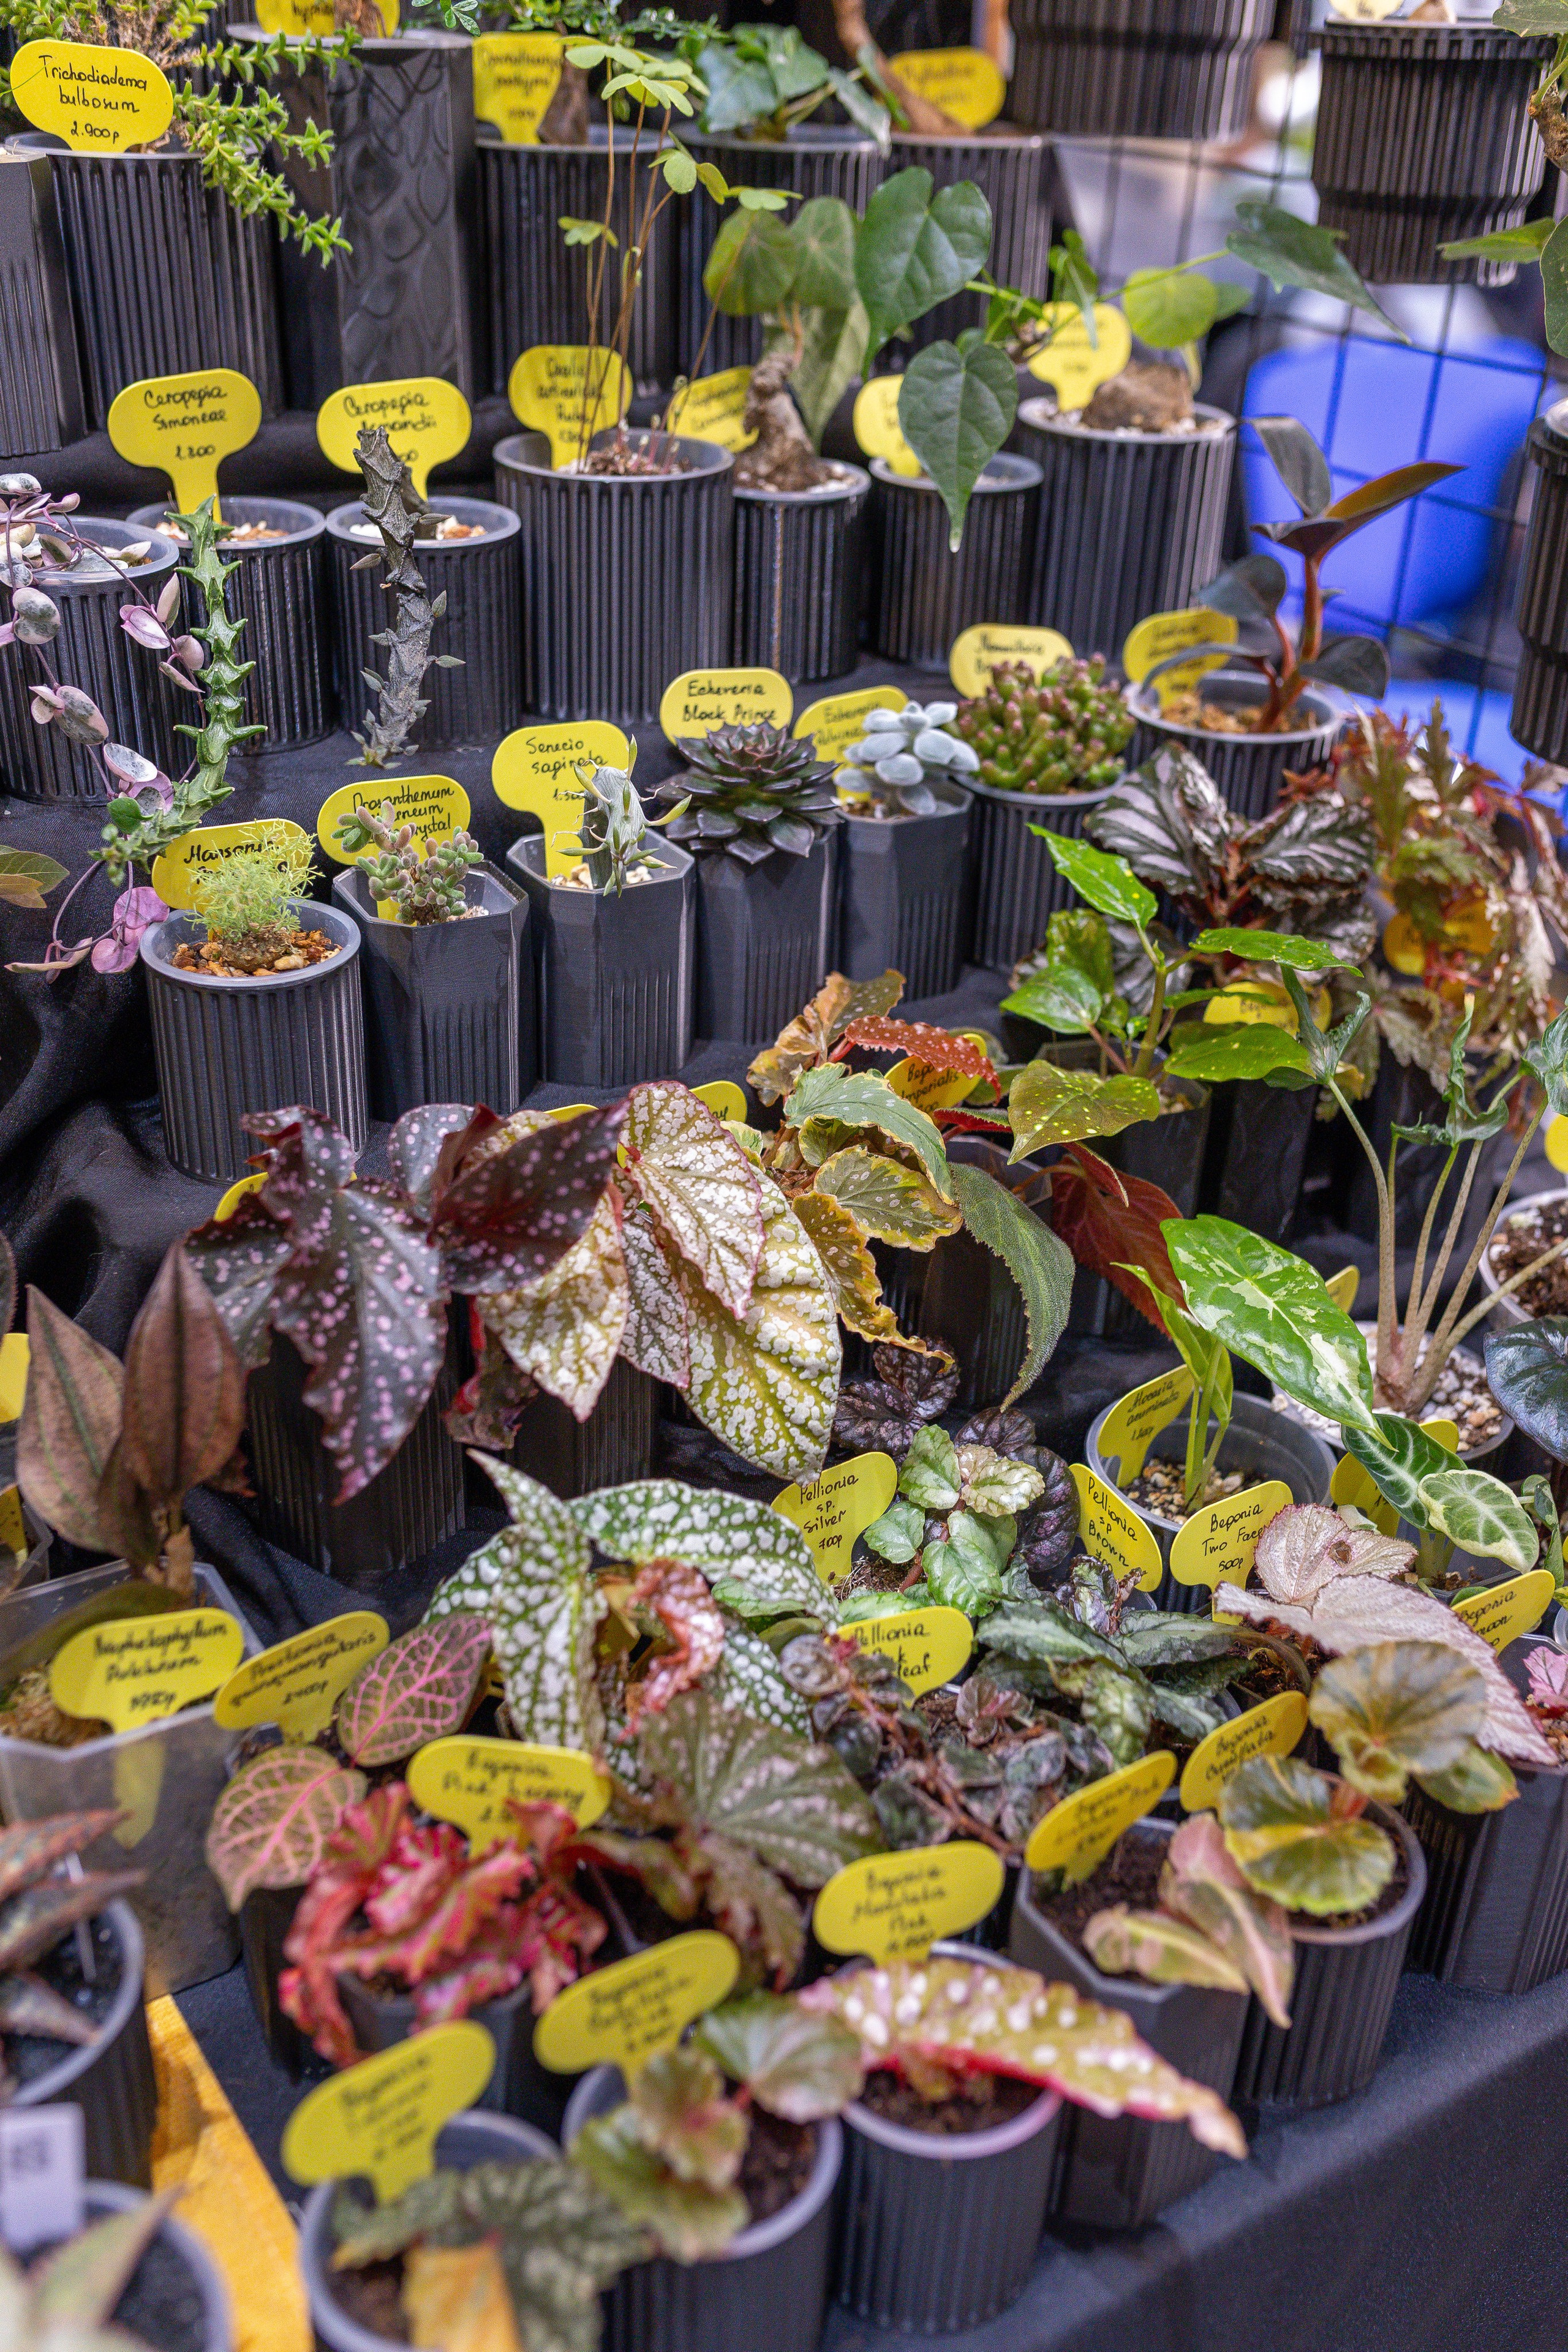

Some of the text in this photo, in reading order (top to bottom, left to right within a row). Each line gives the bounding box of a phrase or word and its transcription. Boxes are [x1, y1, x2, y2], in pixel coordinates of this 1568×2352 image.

[39, 55, 147, 91] Trichodiadema
[59, 85, 140, 113] bulbosum
[526, 737, 584, 755] Senecio
[801, 1474, 859, 1504] Pellionia
[804, 1510, 846, 1533] Silver
[1088, 1476, 1137, 1541] Pellionia
[1210, 1504, 1264, 1532] Begonia
[1088, 1520, 1129, 1567] Brown
[1202, 1537, 1228, 1556] Two
